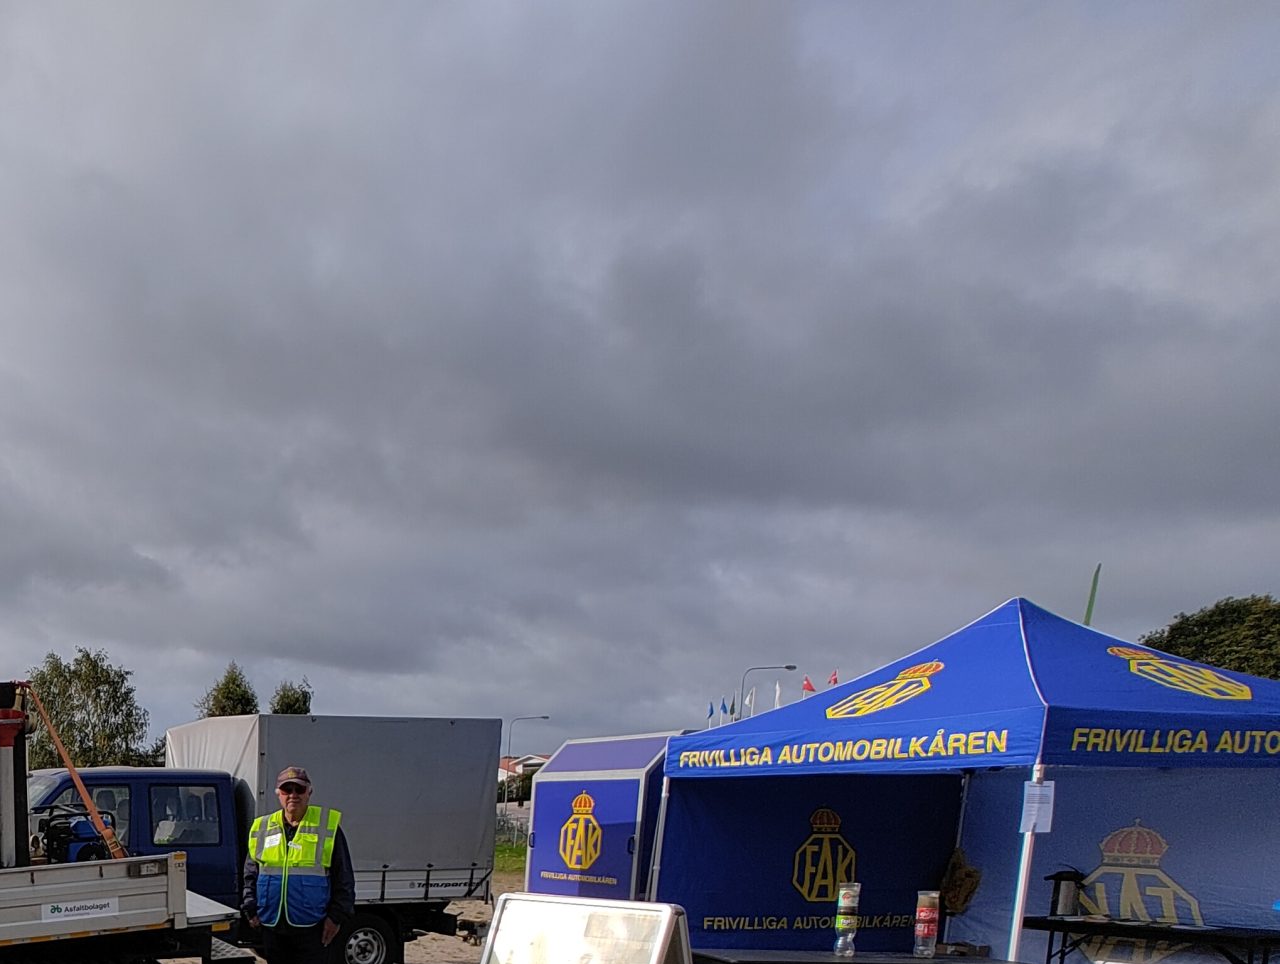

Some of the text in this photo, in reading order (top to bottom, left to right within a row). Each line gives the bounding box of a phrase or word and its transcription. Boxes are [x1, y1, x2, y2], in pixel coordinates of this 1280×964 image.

[679, 728, 1009, 767] FRIVILLIGA AUTOMOBILKÅREN
[1071, 728, 1208, 753] FRIVILLIGA
[563, 814, 600, 868] FAK
[800, 835, 854, 901] FAK
[64, 902, 110, 914] Asfaltbolaget
[704, 916, 788, 930] FRIVILLIGA
[793, 911, 917, 930] AUTOBILKÅREN
